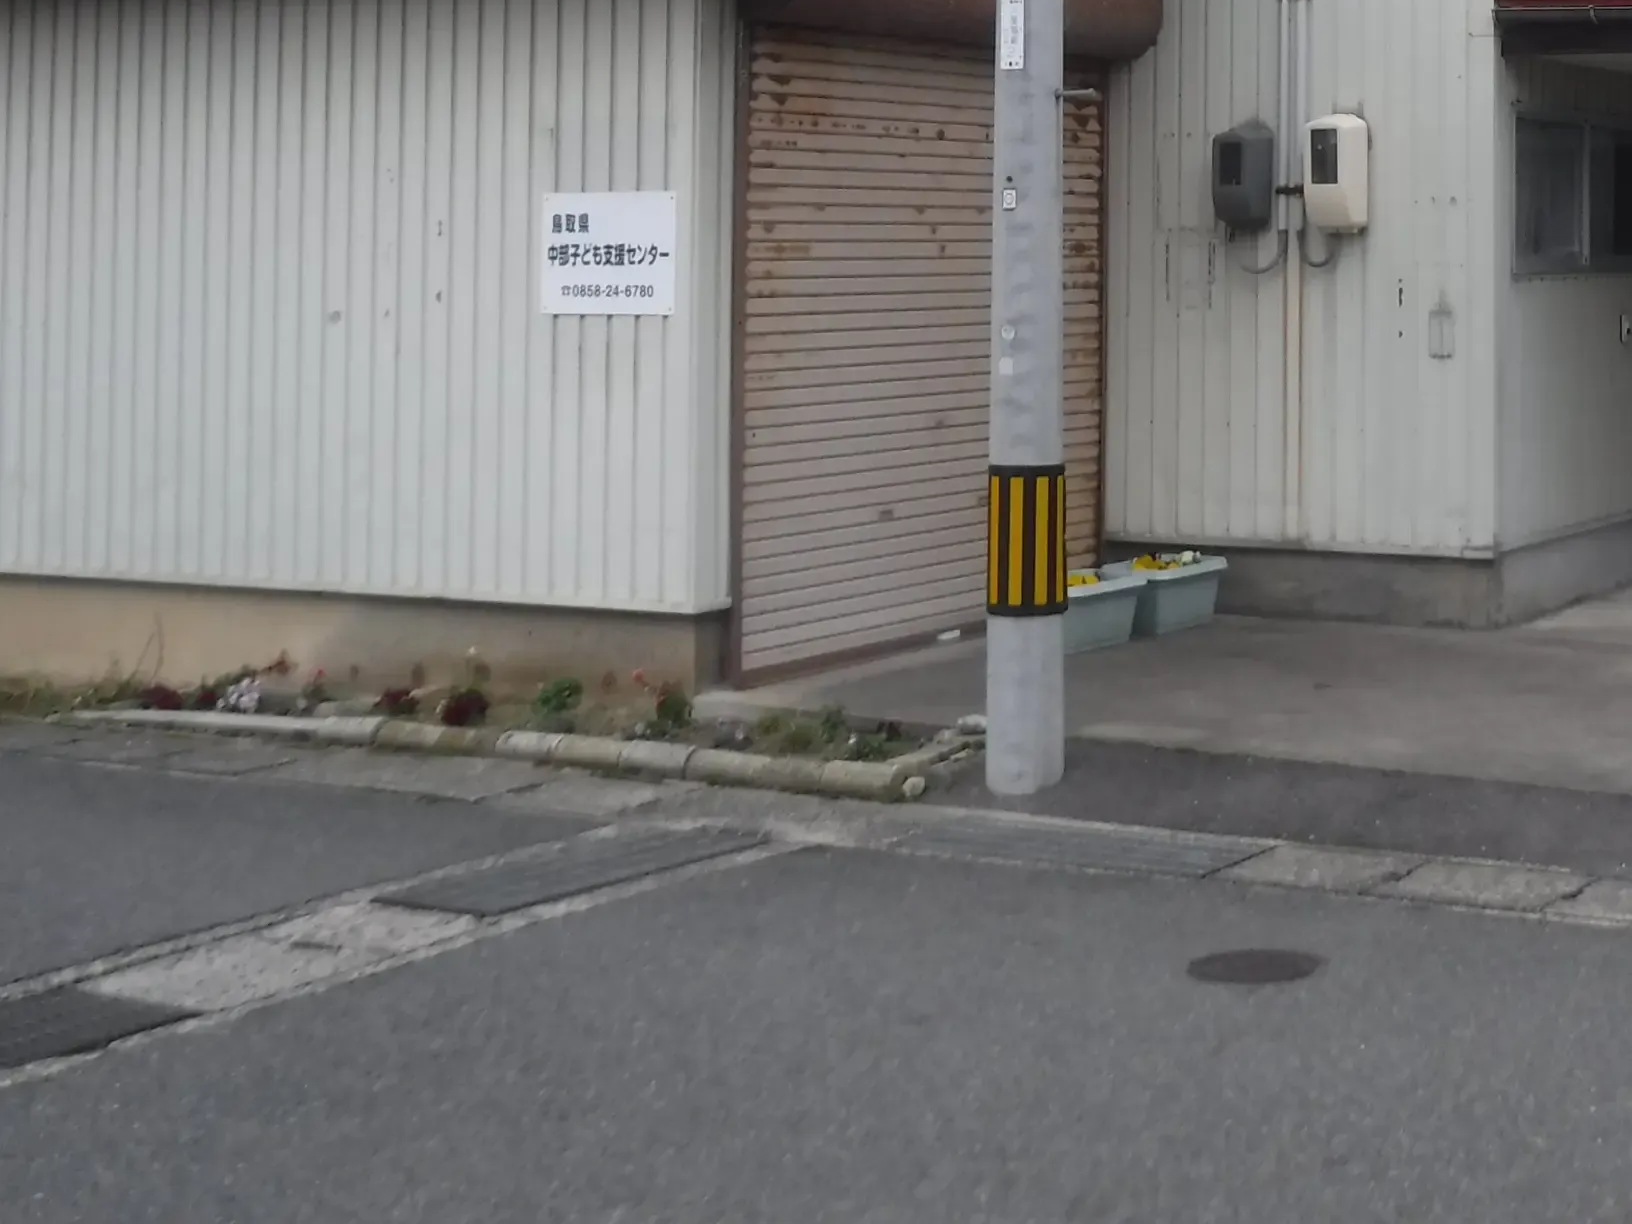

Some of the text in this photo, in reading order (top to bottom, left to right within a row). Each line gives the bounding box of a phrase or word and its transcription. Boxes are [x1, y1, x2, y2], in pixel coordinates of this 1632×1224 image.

[552, 213, 589, 233] 鳥取県
[547, 243, 669, 266] 中部子ども支援センター
